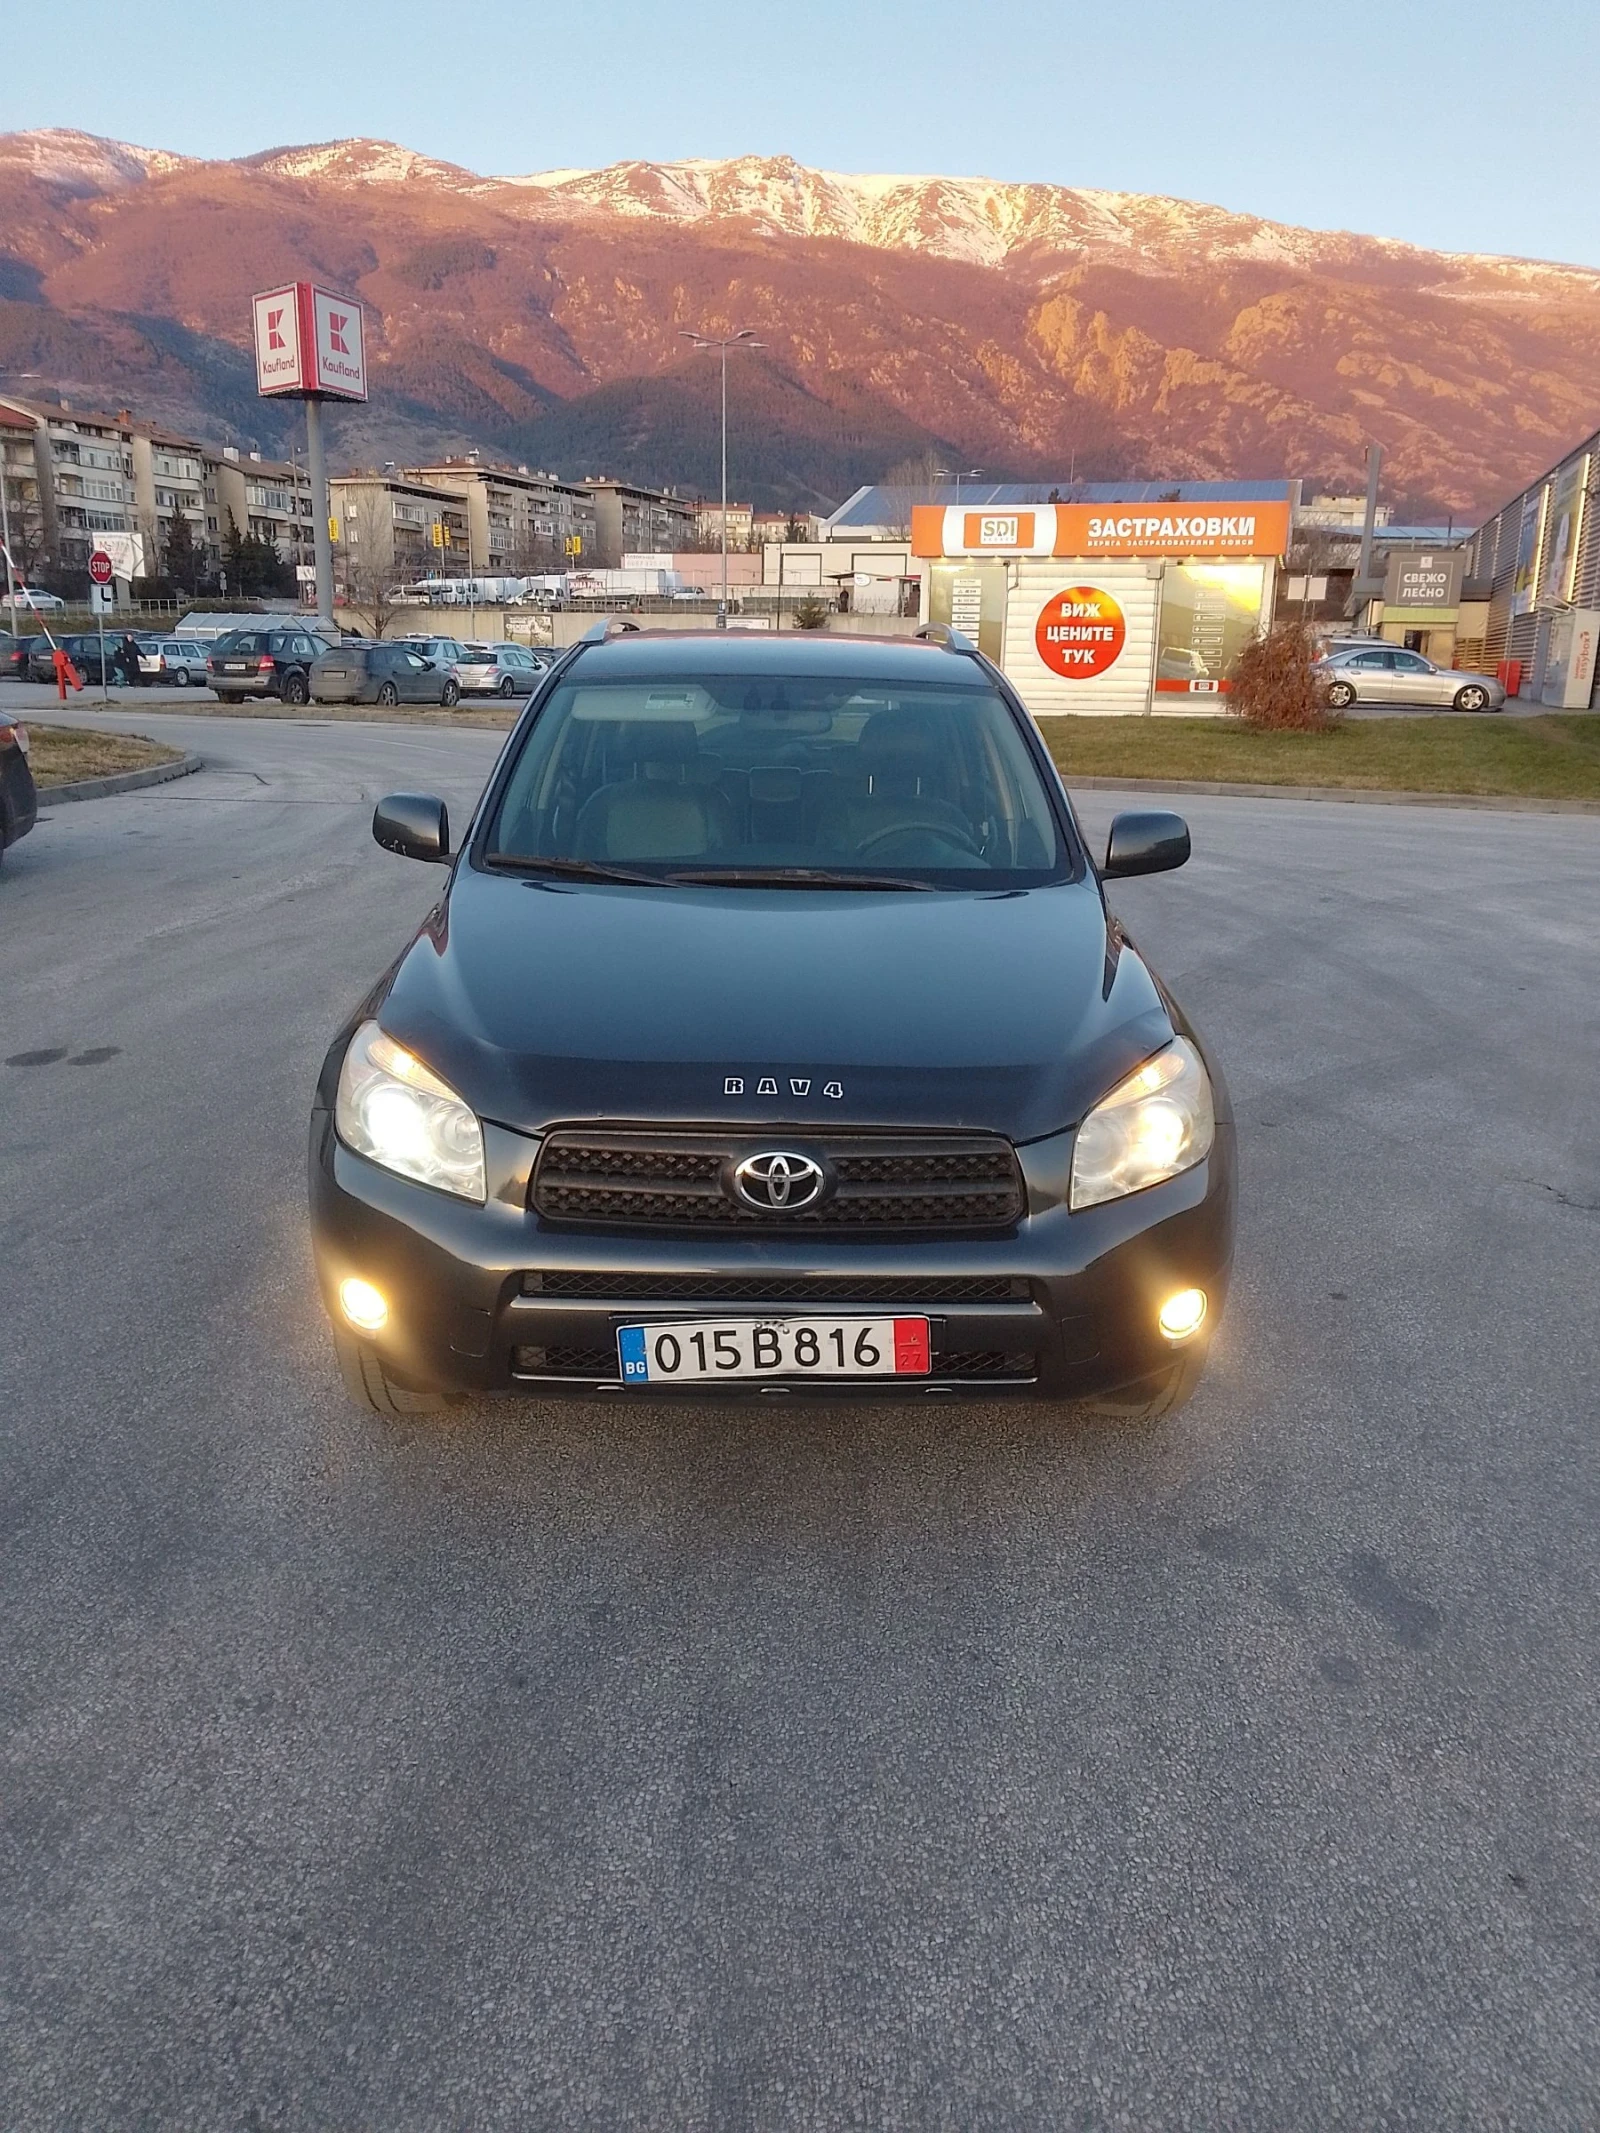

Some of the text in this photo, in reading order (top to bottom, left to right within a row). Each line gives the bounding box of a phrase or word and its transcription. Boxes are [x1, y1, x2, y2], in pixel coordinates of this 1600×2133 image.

[262, 356, 295, 374] Kaufland
[322, 356, 360, 380] Kaufland
[983, 520, 1015, 537] SDI
[1087, 516, 1256, 538] ЗАСТРАХОВКИ
[92, 561, 110, 573] STOP
[1403, 573, 1447, 583] СВЕЖО
[1402, 587, 1445, 598] ЛЕСНО
[1061, 602, 1101, 618] ВИЖ
[1046, 626, 1114, 643] ЦЕНИТЕ
[1061, 648, 1095, 664] ТУК
[1579, 637, 1590, 680] easybox
[900, 1351, 921, 1366] 27
[626, 1361, 645, 1374] BG
